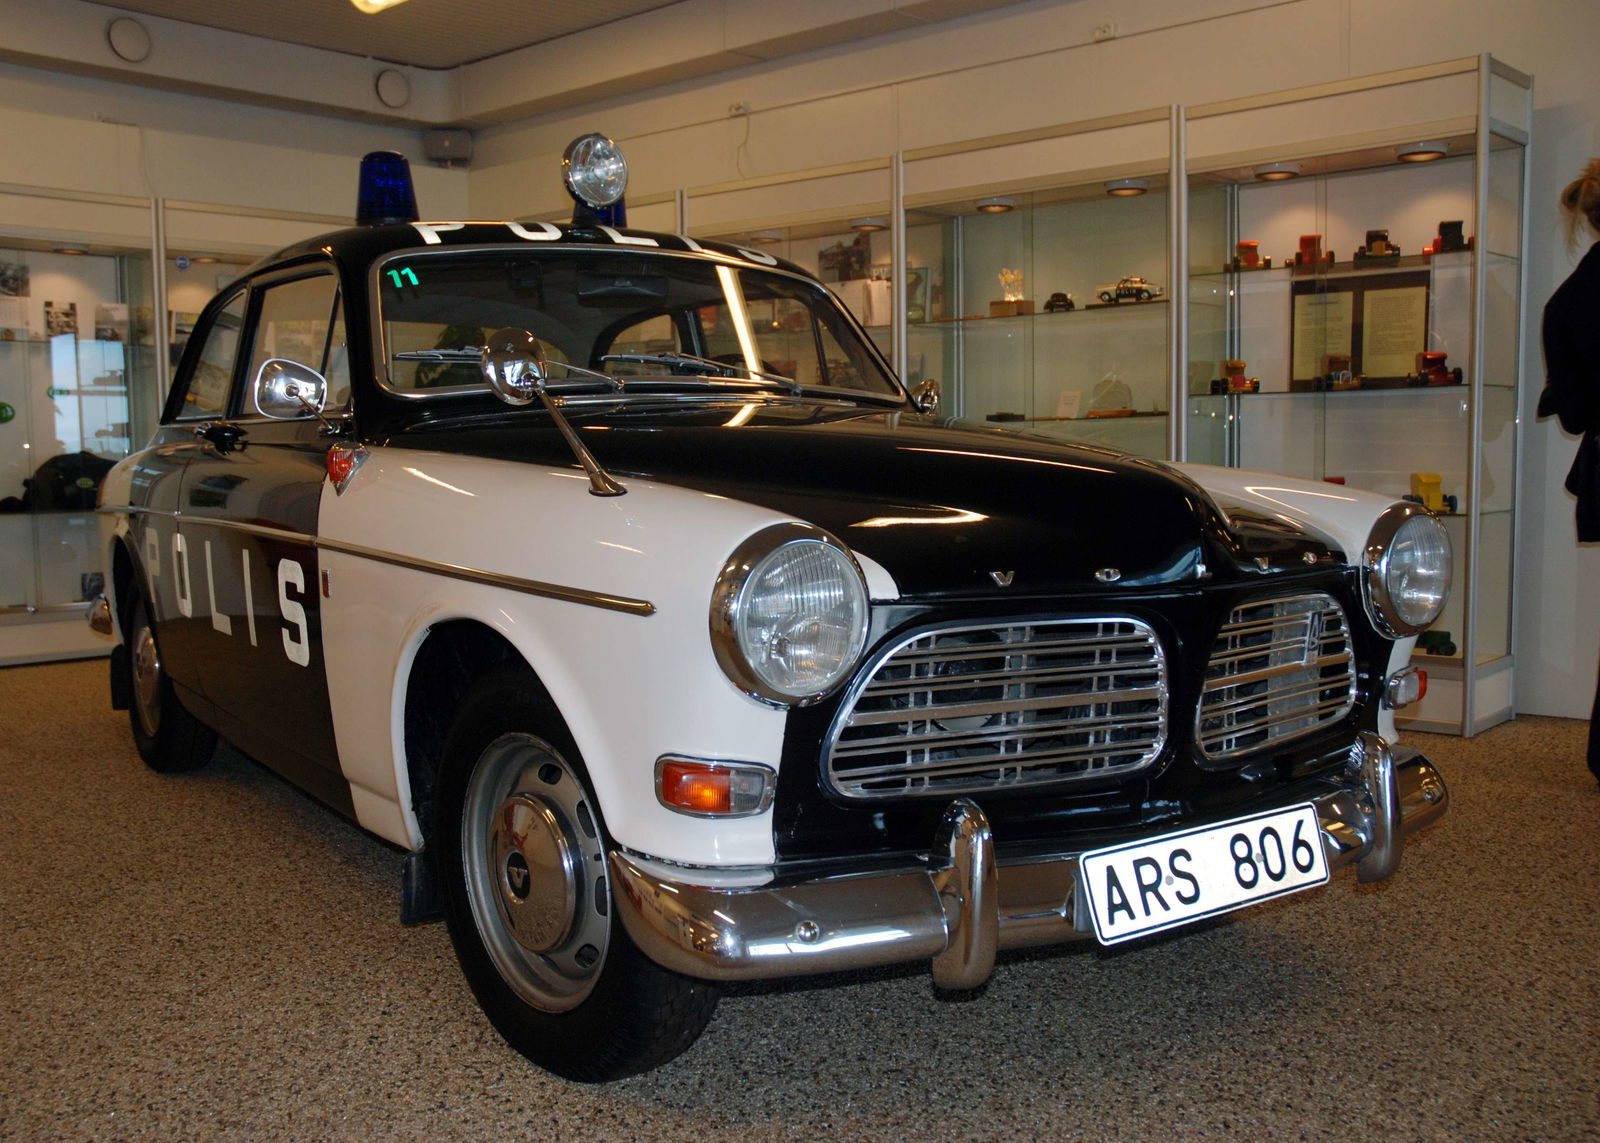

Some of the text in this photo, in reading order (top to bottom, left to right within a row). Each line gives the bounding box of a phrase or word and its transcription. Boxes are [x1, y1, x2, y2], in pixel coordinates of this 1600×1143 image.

[387, 267, 419, 288] 11
[145, 527, 310, 667] POLIS
[1106, 819, 1314, 926] ARS 806
